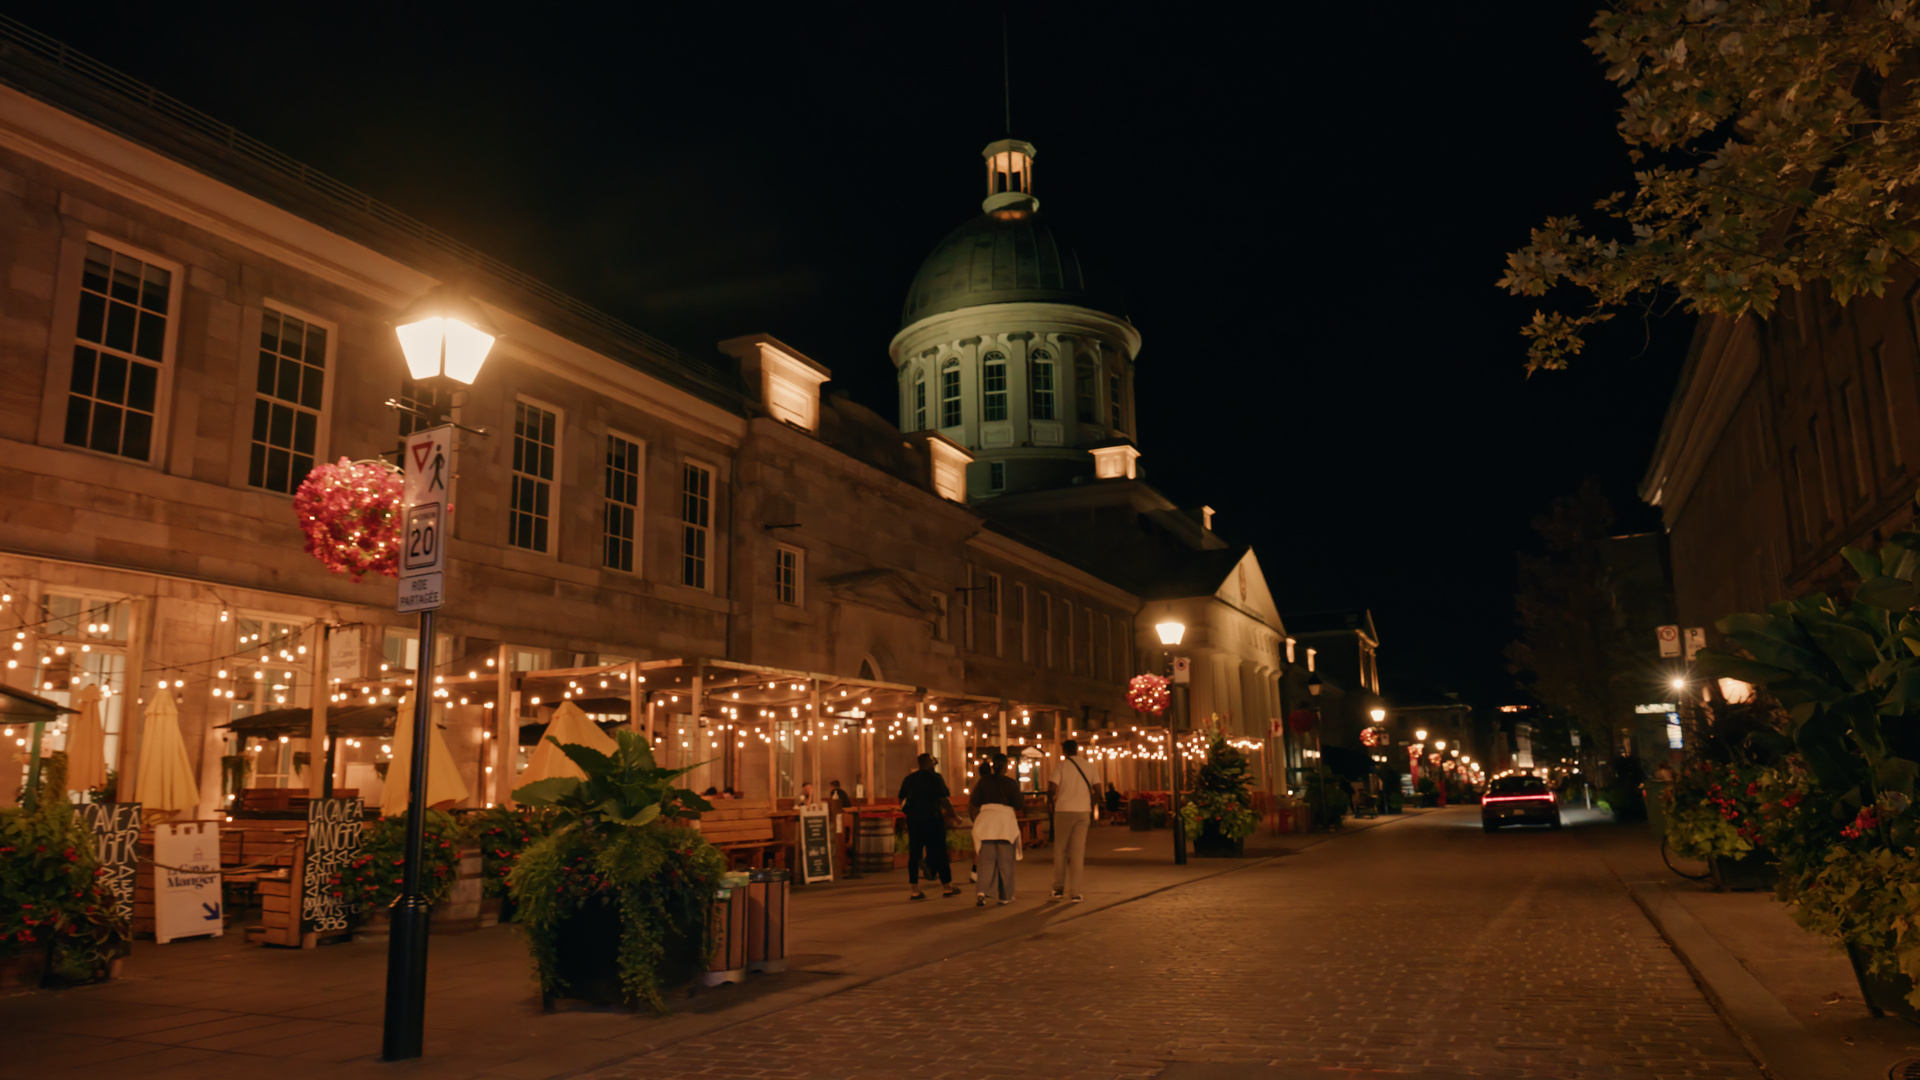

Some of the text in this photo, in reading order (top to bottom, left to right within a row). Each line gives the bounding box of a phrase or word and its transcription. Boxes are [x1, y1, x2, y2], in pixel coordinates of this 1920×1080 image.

[409, 526, 434, 557] 20
[411, 579, 428, 591] RUE
[400, 590, 439, 607] PARTAGÉE
[308, 800, 323, 824] LA
[324, 799, 356, 824] CAVE
[307, 822, 363, 852] MANGER
[167, 875, 217, 890] Manger
[313, 915, 348, 932] 386
